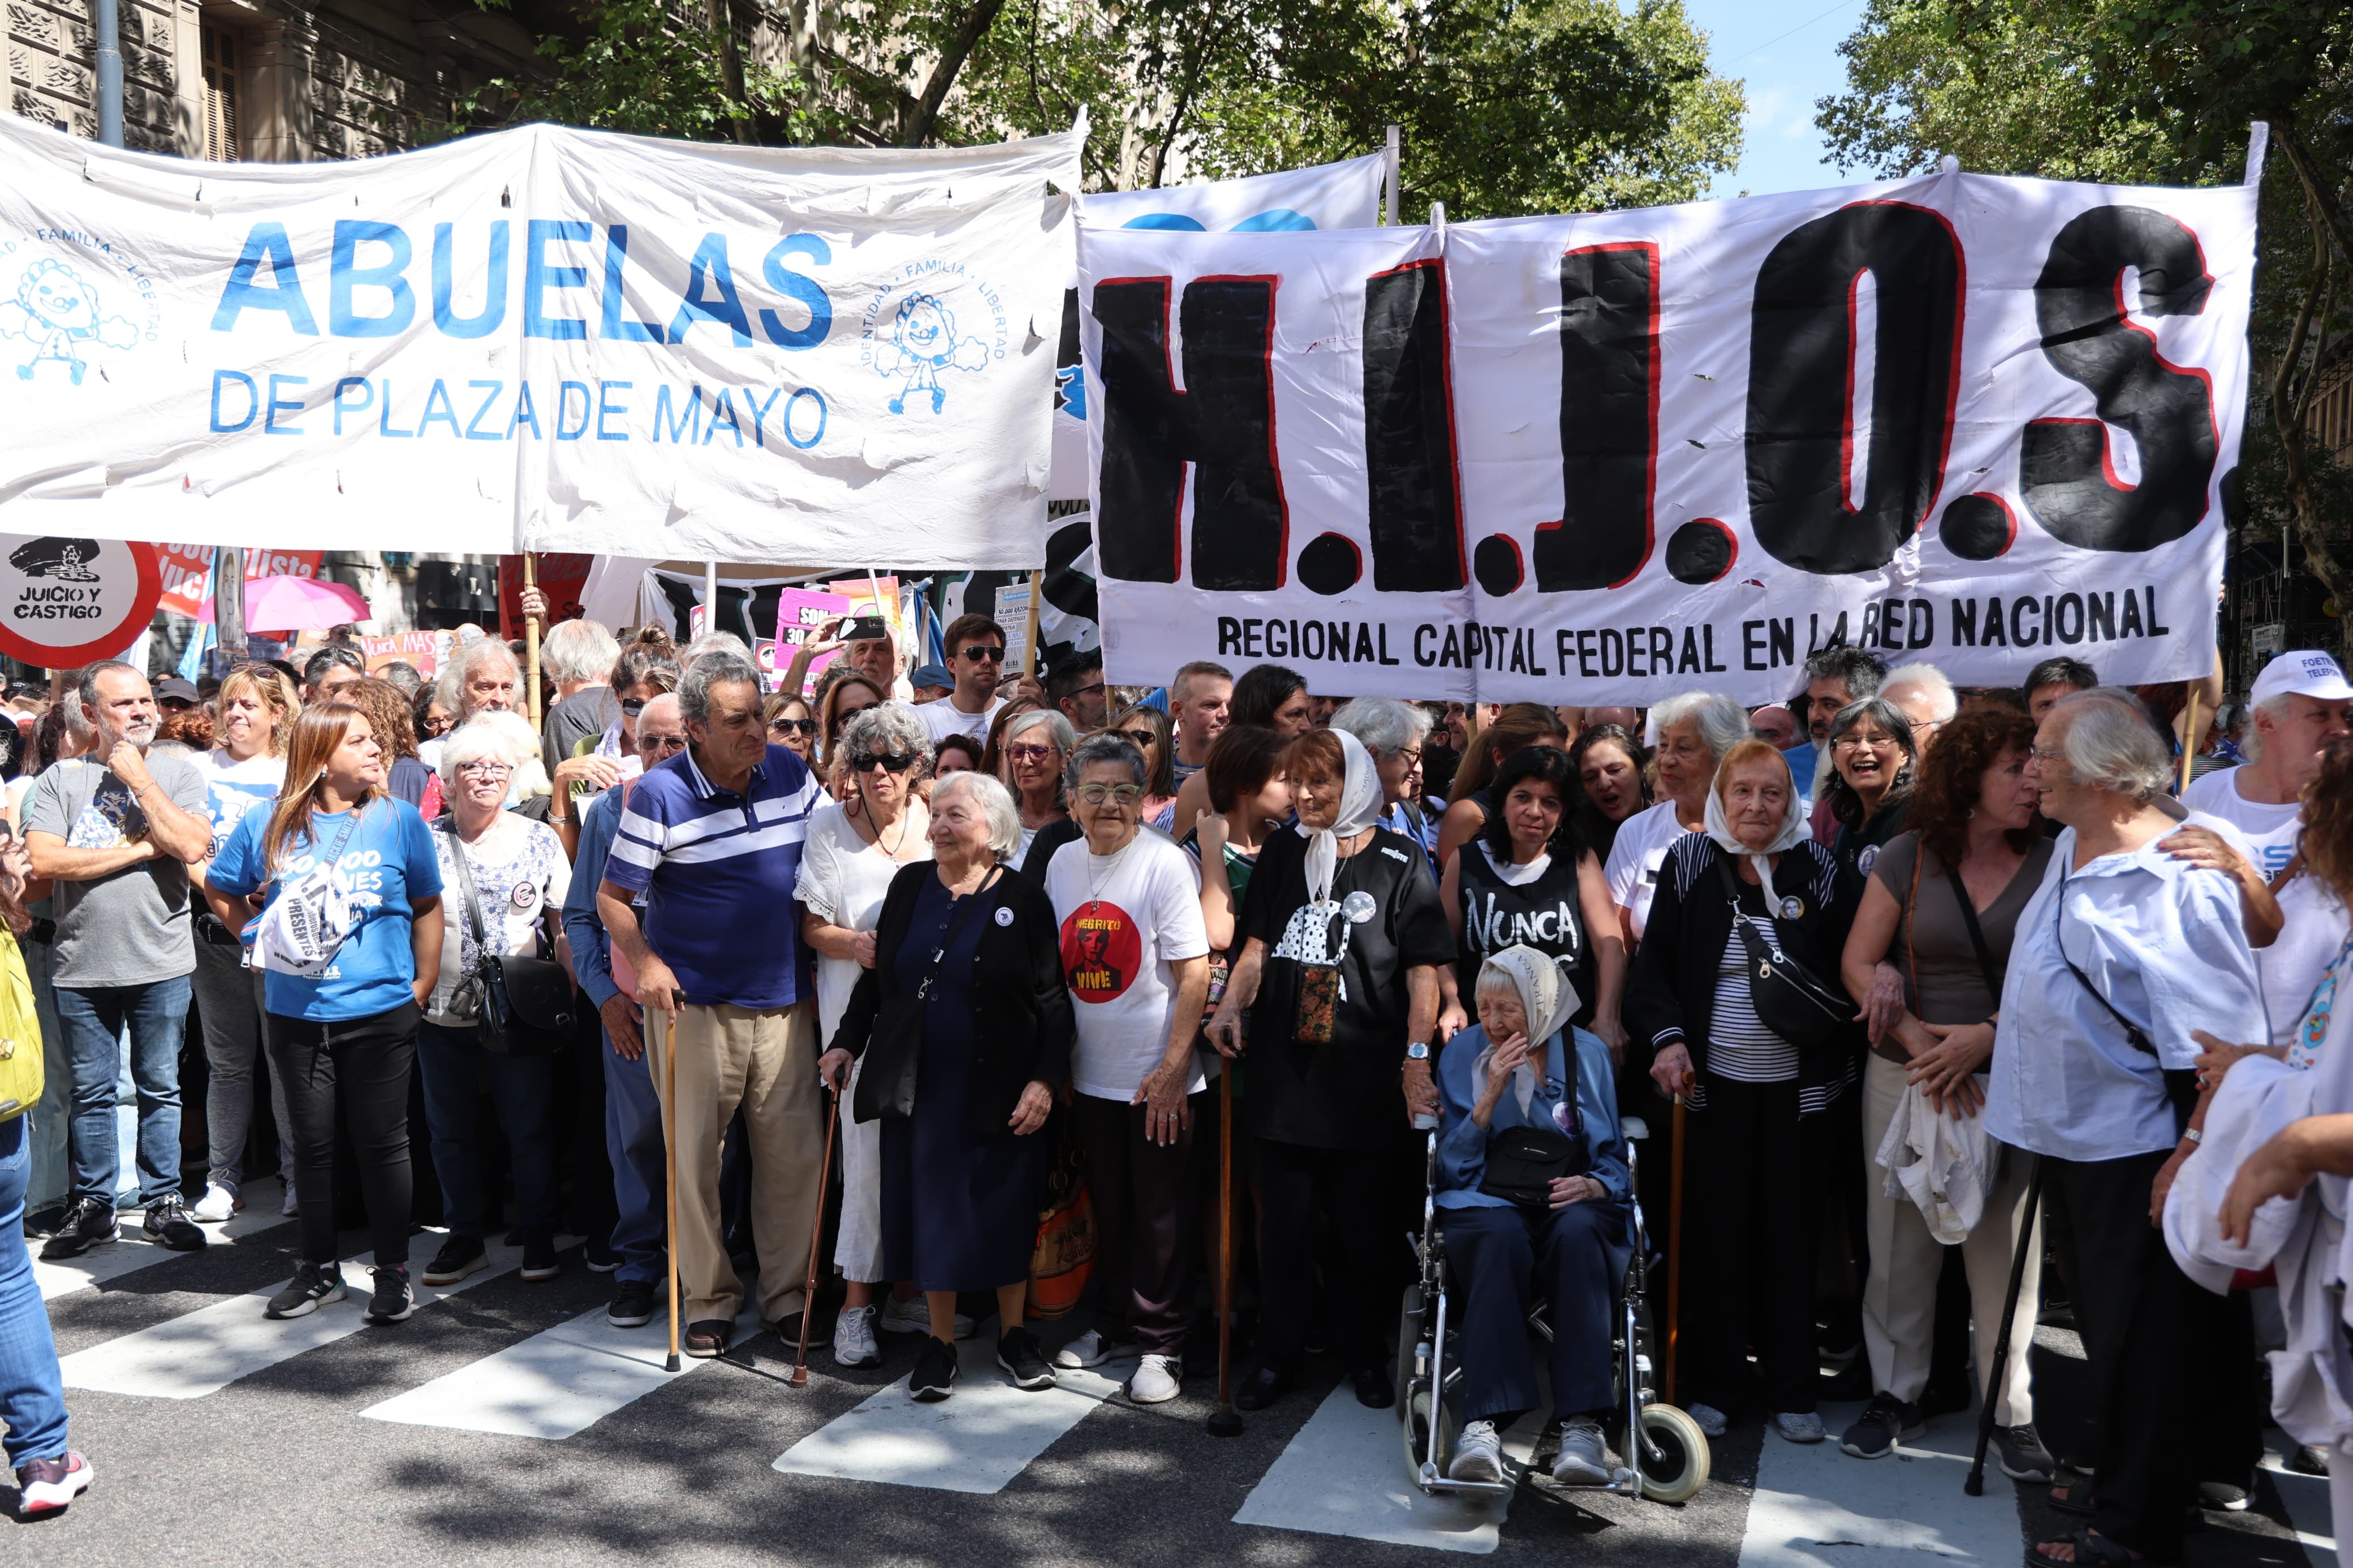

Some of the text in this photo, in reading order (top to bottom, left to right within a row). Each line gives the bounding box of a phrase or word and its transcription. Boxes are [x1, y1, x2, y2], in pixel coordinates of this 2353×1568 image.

[37, 228, 160, 342] FAMILIA LIBERTAD
[212, 220, 832, 351] ABUELAS
[861, 260, 1007, 366] IDENTIDAD FAMILIA LIBERTAD
[210, 370, 828, 448] DE PLAZA DE MAYO
[14, 604, 102, 619] CASTIGO
[19, 586, 102, 602] JUICIO Y
[1014, 606, 1028, 614] RAZON
[360, 633, 436, 658] NUNCA MAS
[1218, 586, 2169, 677] REGIONAL CAPITAL FEDERAL EN LA RED NACIONAL
[326, 816, 357, 863] JACKIE SMITH
[288, 898, 317, 957] PRESENTES
[1076, 918, 1121, 931] NEGRITO
[1465, 888, 1578, 952] NUNCA
[1076, 970, 1111, 989] VIVE
